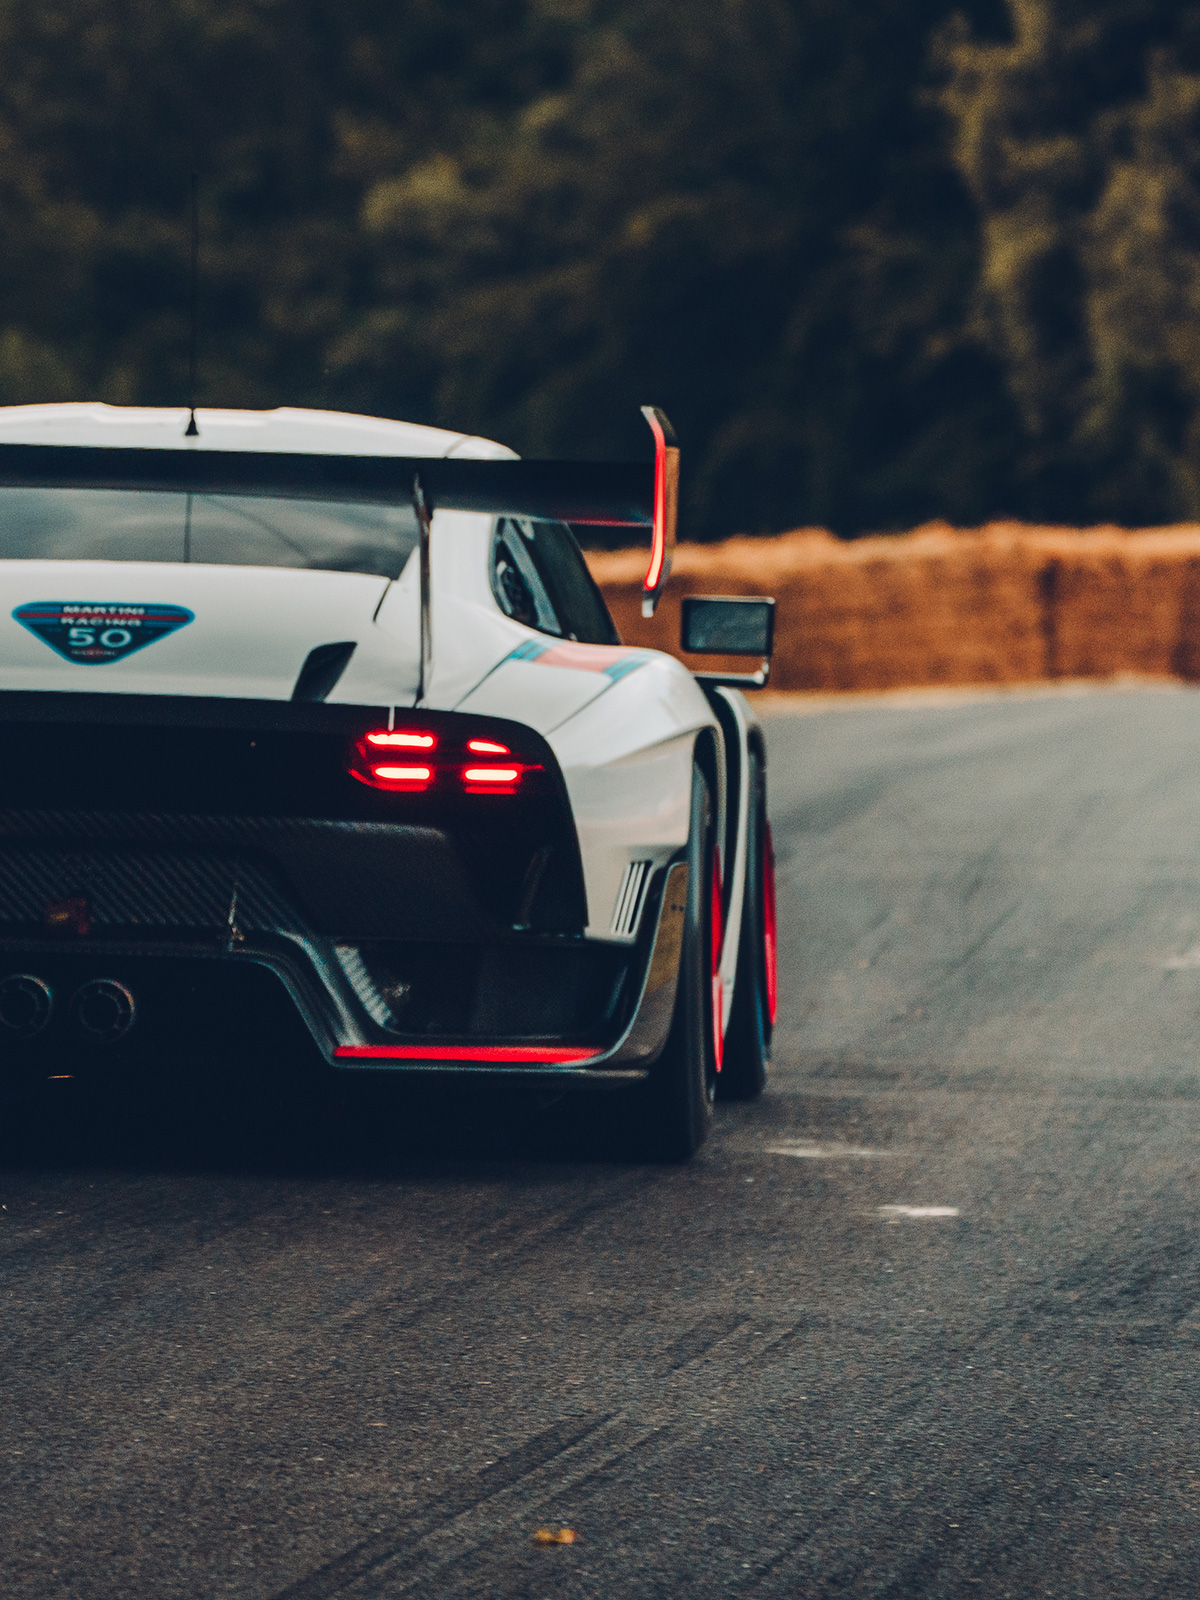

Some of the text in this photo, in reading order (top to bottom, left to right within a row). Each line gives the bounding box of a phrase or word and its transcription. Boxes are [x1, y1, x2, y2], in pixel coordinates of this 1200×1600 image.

[63, 605, 145, 614] MARTINI
[60, 617, 142, 626] RACING
[68, 627, 132, 648] 50
